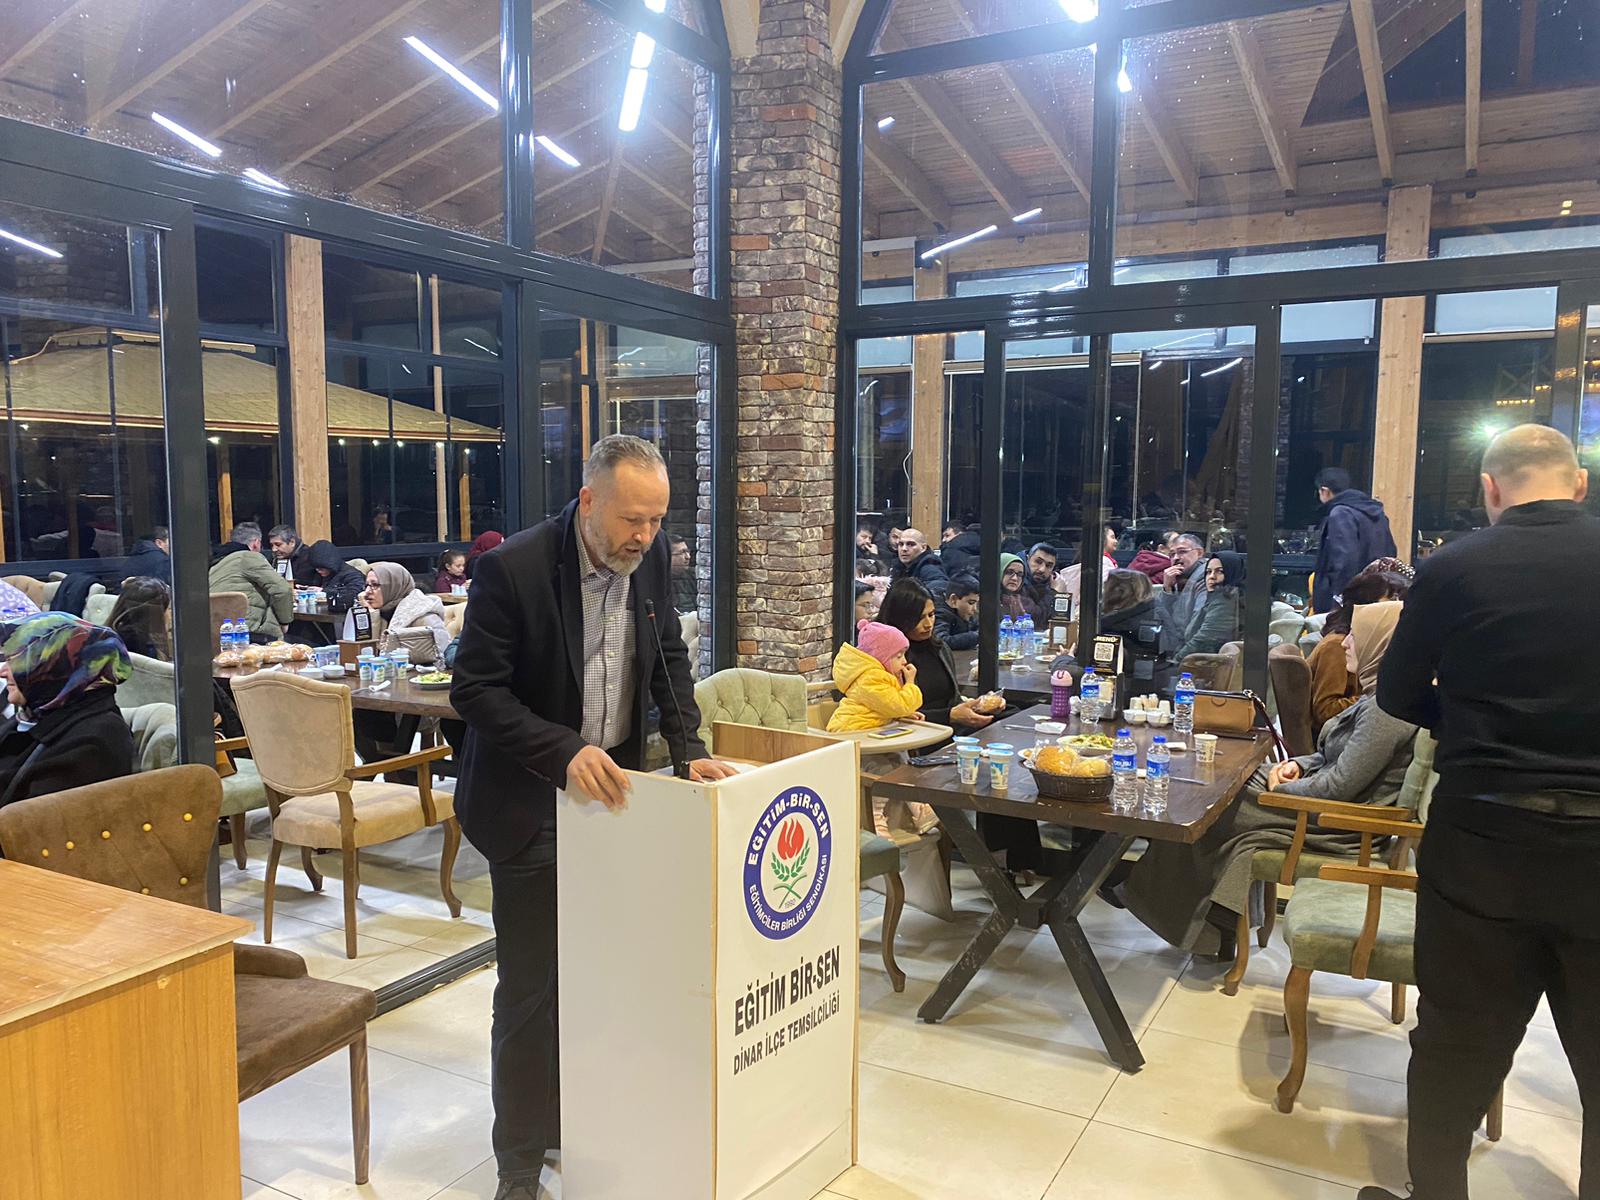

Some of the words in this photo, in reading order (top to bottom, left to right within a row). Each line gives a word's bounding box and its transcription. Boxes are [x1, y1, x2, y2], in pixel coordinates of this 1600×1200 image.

[749, 884, 780, 931] EĞİTİMCİLER
[781, 907, 806, 931] BİRLİĞİ
[805, 854, 827, 911] SENDİKASI
[733, 1046, 763, 1076] DİNAR
[765, 1027, 785, 1056] İLÇE
[788, 989, 840, 1043] TEMSİLCİLİĞİ
[735, 971, 786, 1036] EĞİTİM
[790, 945, 840, 1005] BİR-SEN
